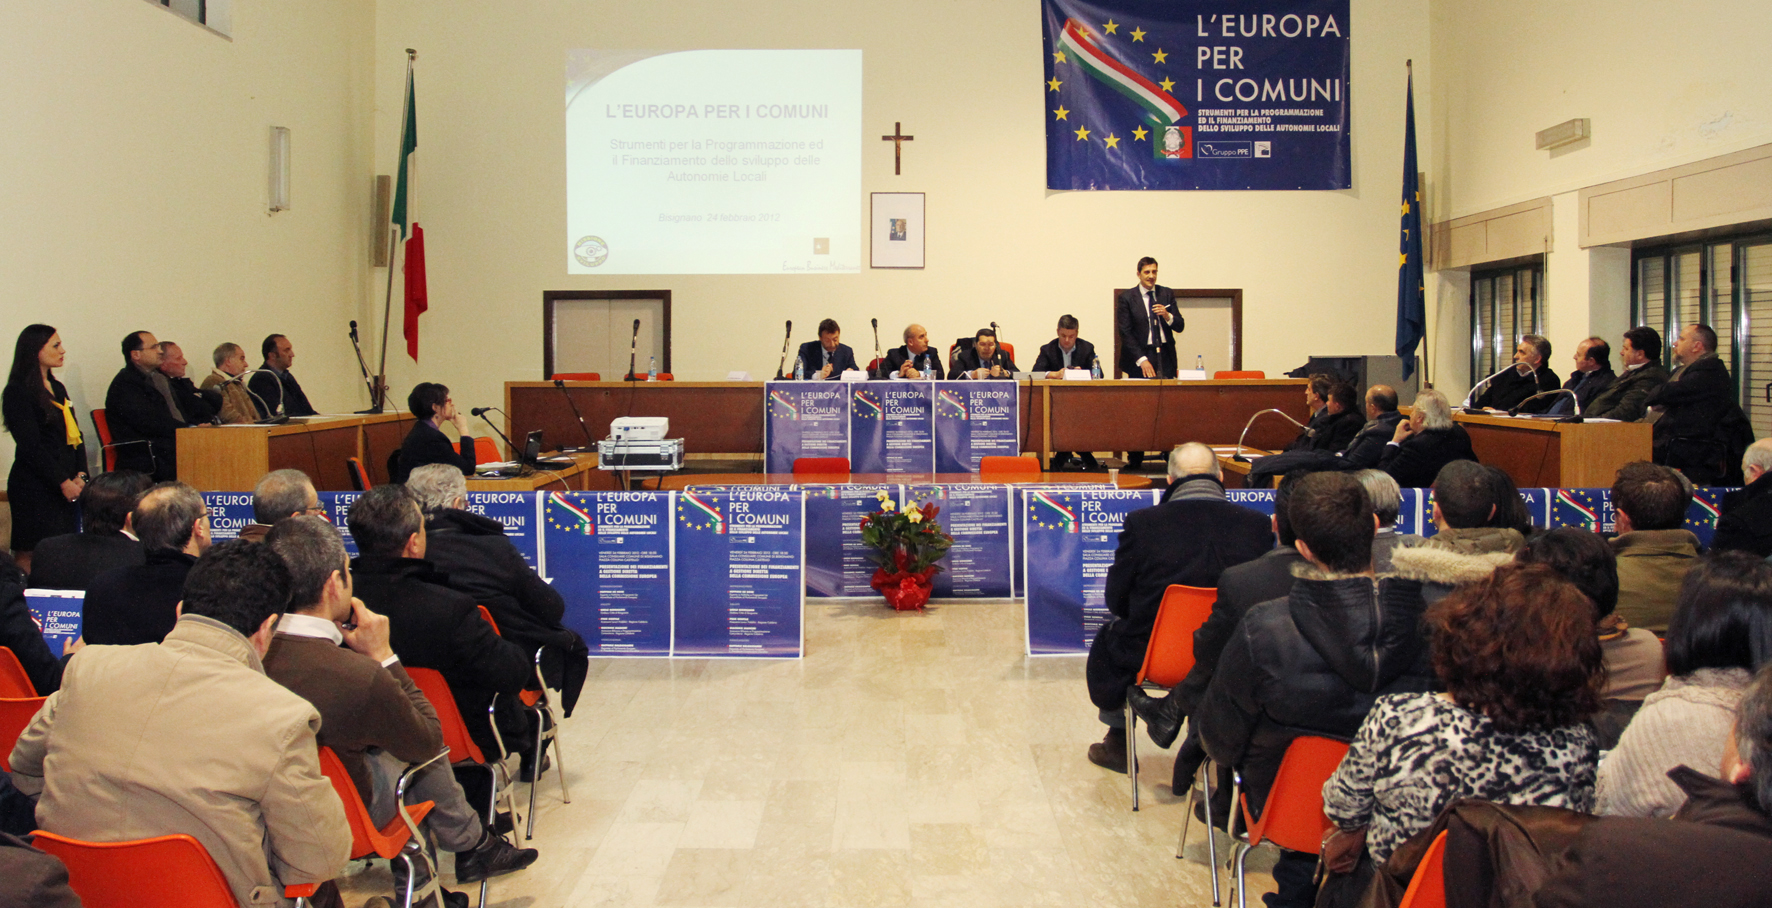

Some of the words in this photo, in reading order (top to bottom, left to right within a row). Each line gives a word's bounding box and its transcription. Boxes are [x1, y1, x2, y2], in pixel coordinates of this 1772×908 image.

[1197, 14, 1341, 37] L'EUROPA
[1197, 46, 1244, 69] PER
[1198, 78, 1202, 102] I
[1214, 78, 1340, 102] COMUNI
[606, 104, 698, 119] L'EUROPA
[704, 104, 740, 118] PER
[746, 104, 750, 118] I
[756, 104, 828, 119] COMUNI
[610, 139, 666, 150] Strumenti
[669, 141, 688, 152] per
[692, 139, 702, 150] la
[706, 139, 806, 152] Programmazione
[809, 139, 823, 150] ed
[612, 155, 618, 165] il
[622, 155, 706, 165] Finanziamento
[711, 155, 738, 165] dello
[742, 155, 789, 168] sviluppo
[794, 155, 820, 165] delle
[667, 171, 729, 182] Autonomie
[733, 171, 767, 182] Locali
[658, 214, 702, 223] Bisignano
[707, 214, 718, 222] 24
[720, 214, 755, 222] febbraio
[758, 214, 780, 222] 2012
[206, 495, 254, 506] L'EUROP
[597, 492, 657, 502] L'EUROPA
[730, 492, 789, 501] L'EUROPA
[1082, 491, 1142, 500] L'EUROPA
[1225, 492, 1274, 502] EUROPA
[336, 506, 350, 515] PE
[597, 504, 617, 513] PER
[730, 502, 749, 512] PER
[1082, 501, 1101, 511] PER
[1603, 502, 1614, 511] PE
[598, 515, 600, 524] I
[605, 514, 657, 524] COMUNI
[730, 514, 732, 523] I
[737, 514, 789, 524] COMUNI
[1082, 513, 1084, 522] I
[1089, 512, 1127, 522] COMU
